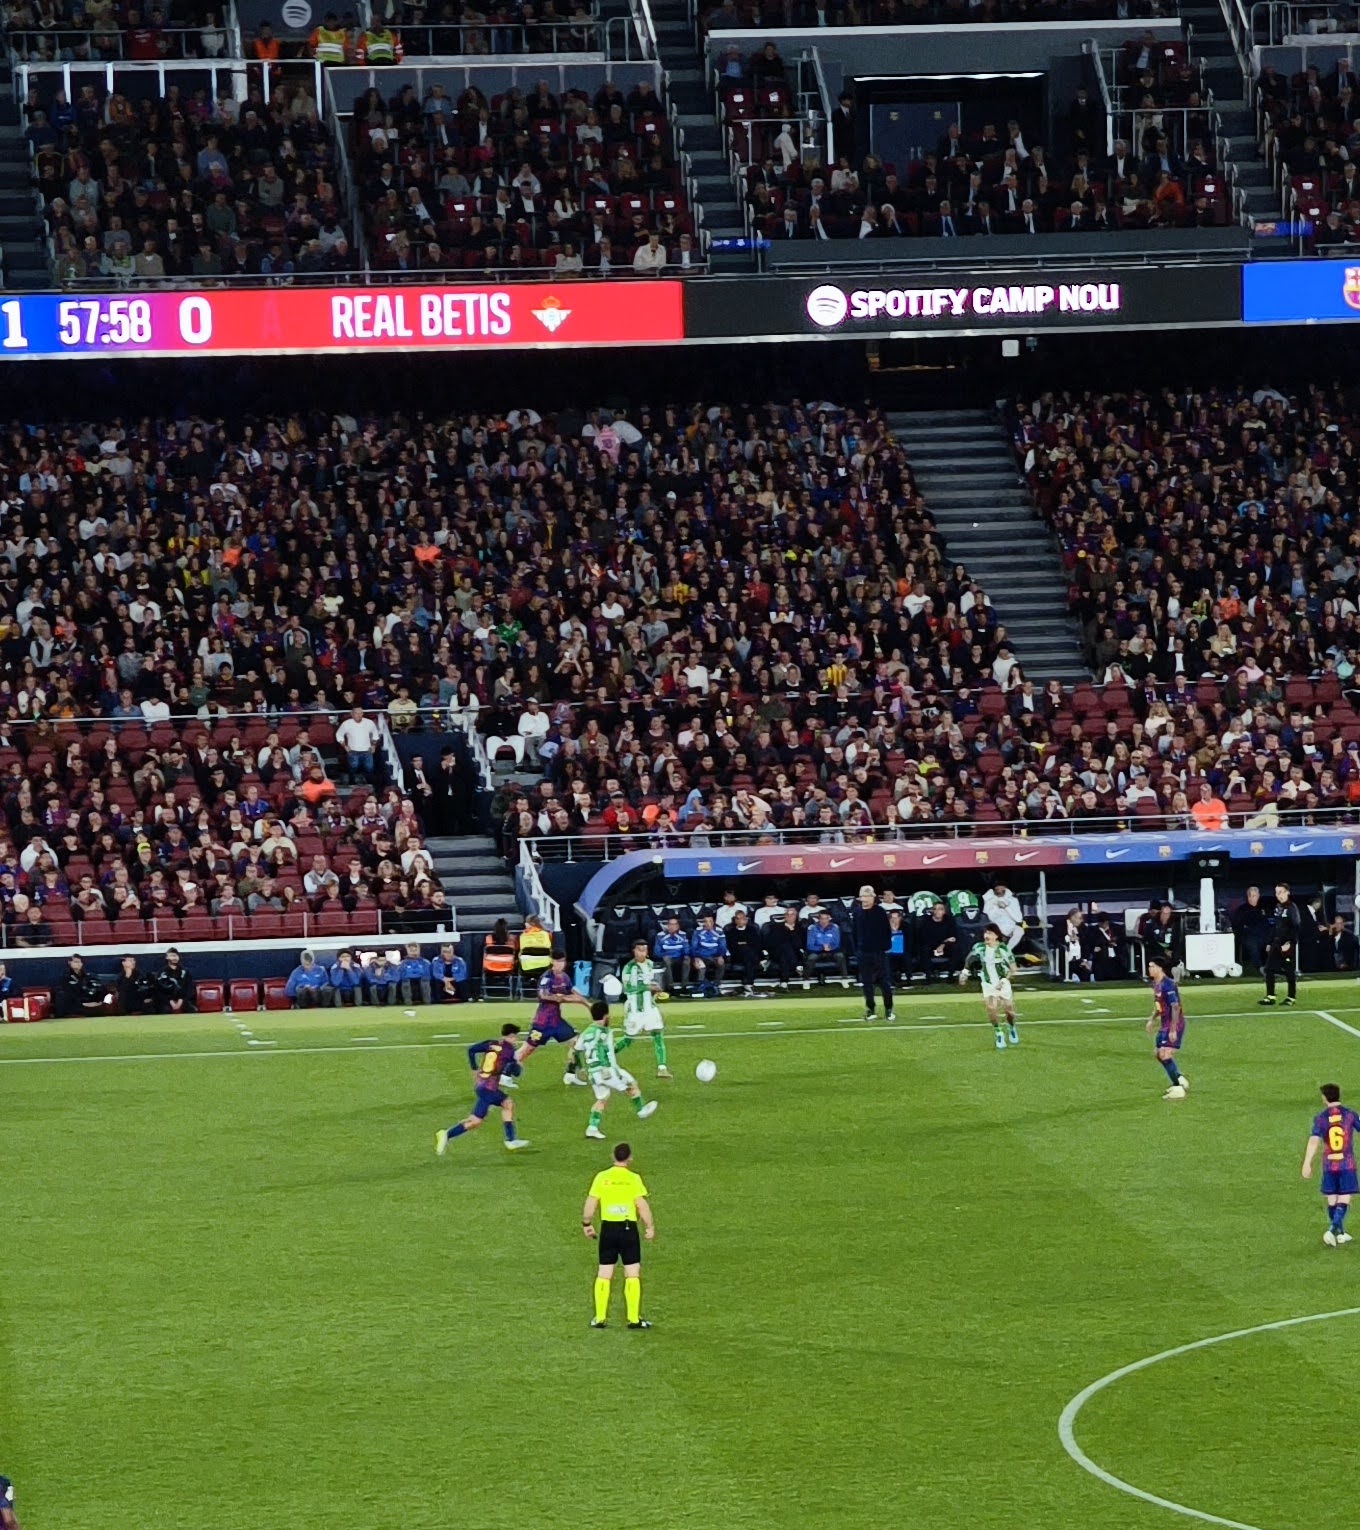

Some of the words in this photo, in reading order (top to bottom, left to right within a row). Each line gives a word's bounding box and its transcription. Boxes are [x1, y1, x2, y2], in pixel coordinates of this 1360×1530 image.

[58, 299, 153, 344] 57:58
[178, 295, 213, 345] 0
[331, 295, 414, 338] REAL
[419, 292, 512, 337] BETIS
[849, 288, 969, 318] SPOTIFY
[971, 286, 1055, 314] CAMP
[1058, 283, 1121, 312] NOU
[0, 300, 28, 348] 1
[1327, 1125, 1346, 1152] 6
